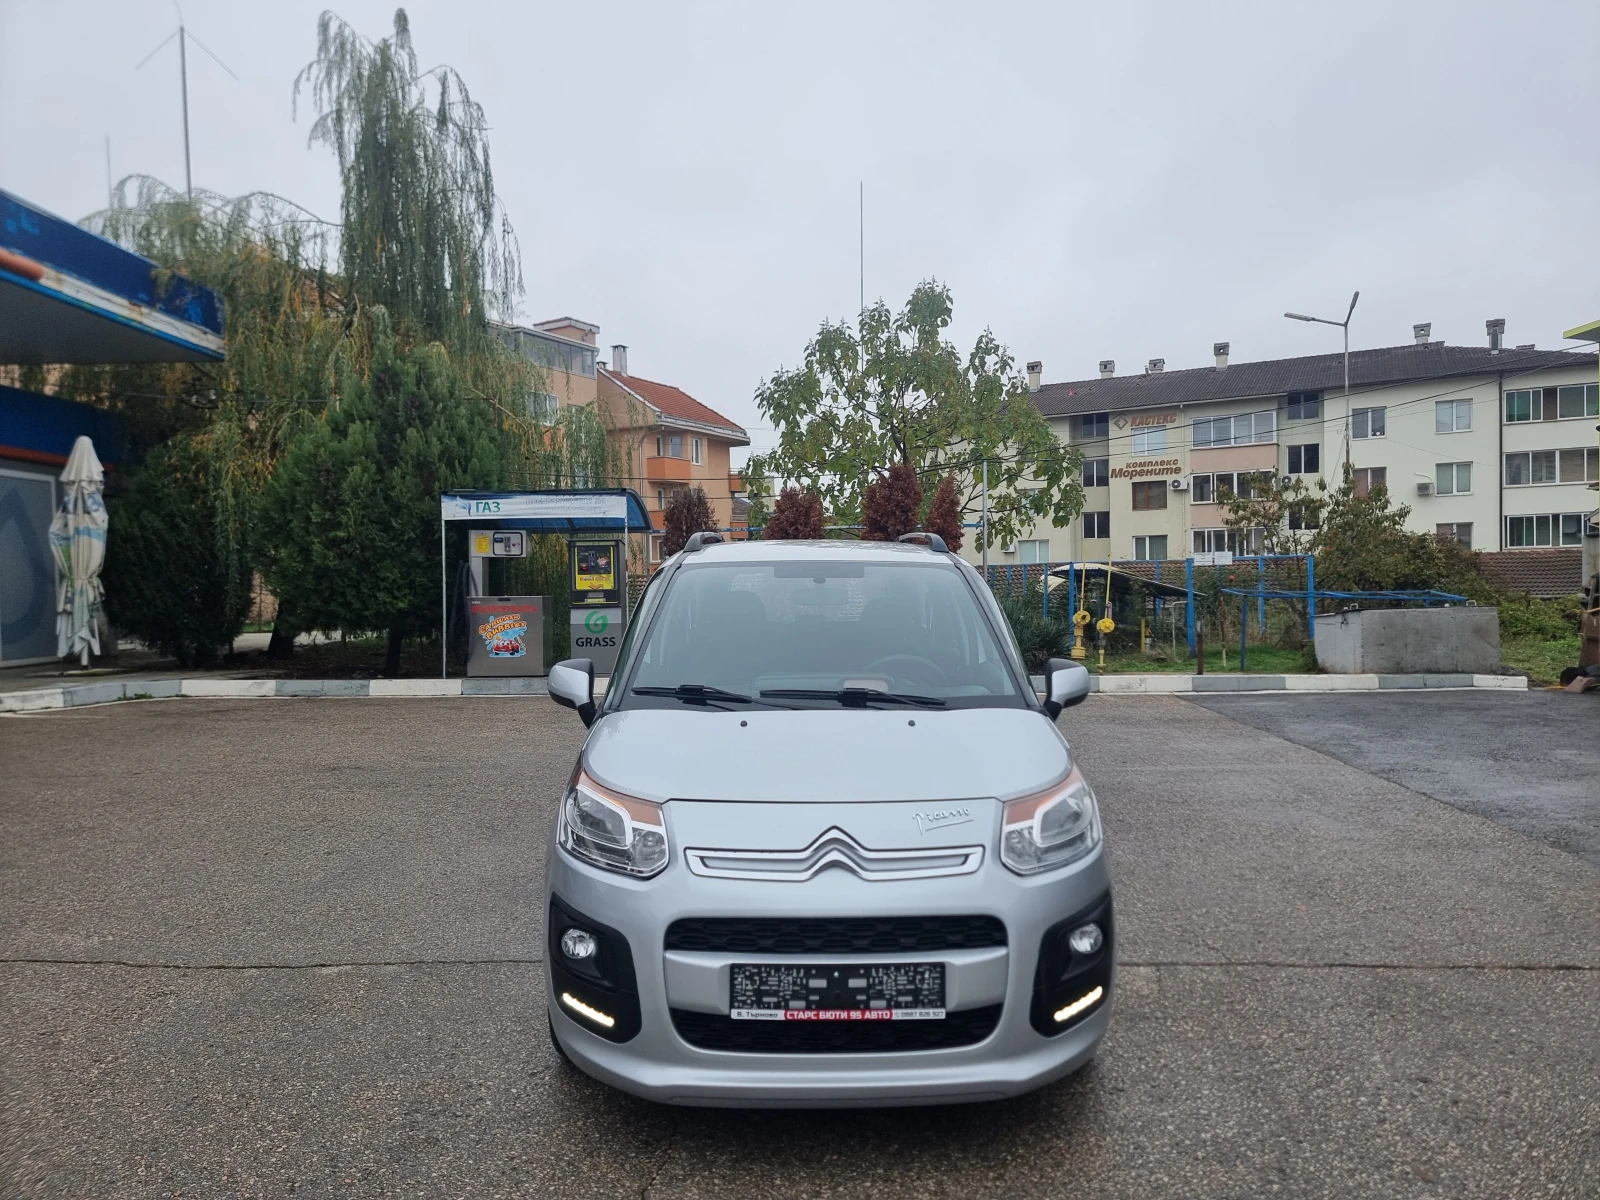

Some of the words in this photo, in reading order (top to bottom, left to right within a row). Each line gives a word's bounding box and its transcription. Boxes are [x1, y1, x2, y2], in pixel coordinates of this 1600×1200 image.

[1130, 412, 1178, 427] КАСТЕКС
[1110, 465, 1182, 480] Морените
[475, 501, 501, 513] ГАЗ
[575, 636, 616, 648] GRASS
[786, 1011, 817, 1020] СТАРС
[819, 1011, 848, 1020] БЮТИ
[850, 1011, 863, 1020] 95
[864, 1011, 890, 1020] АВТО
